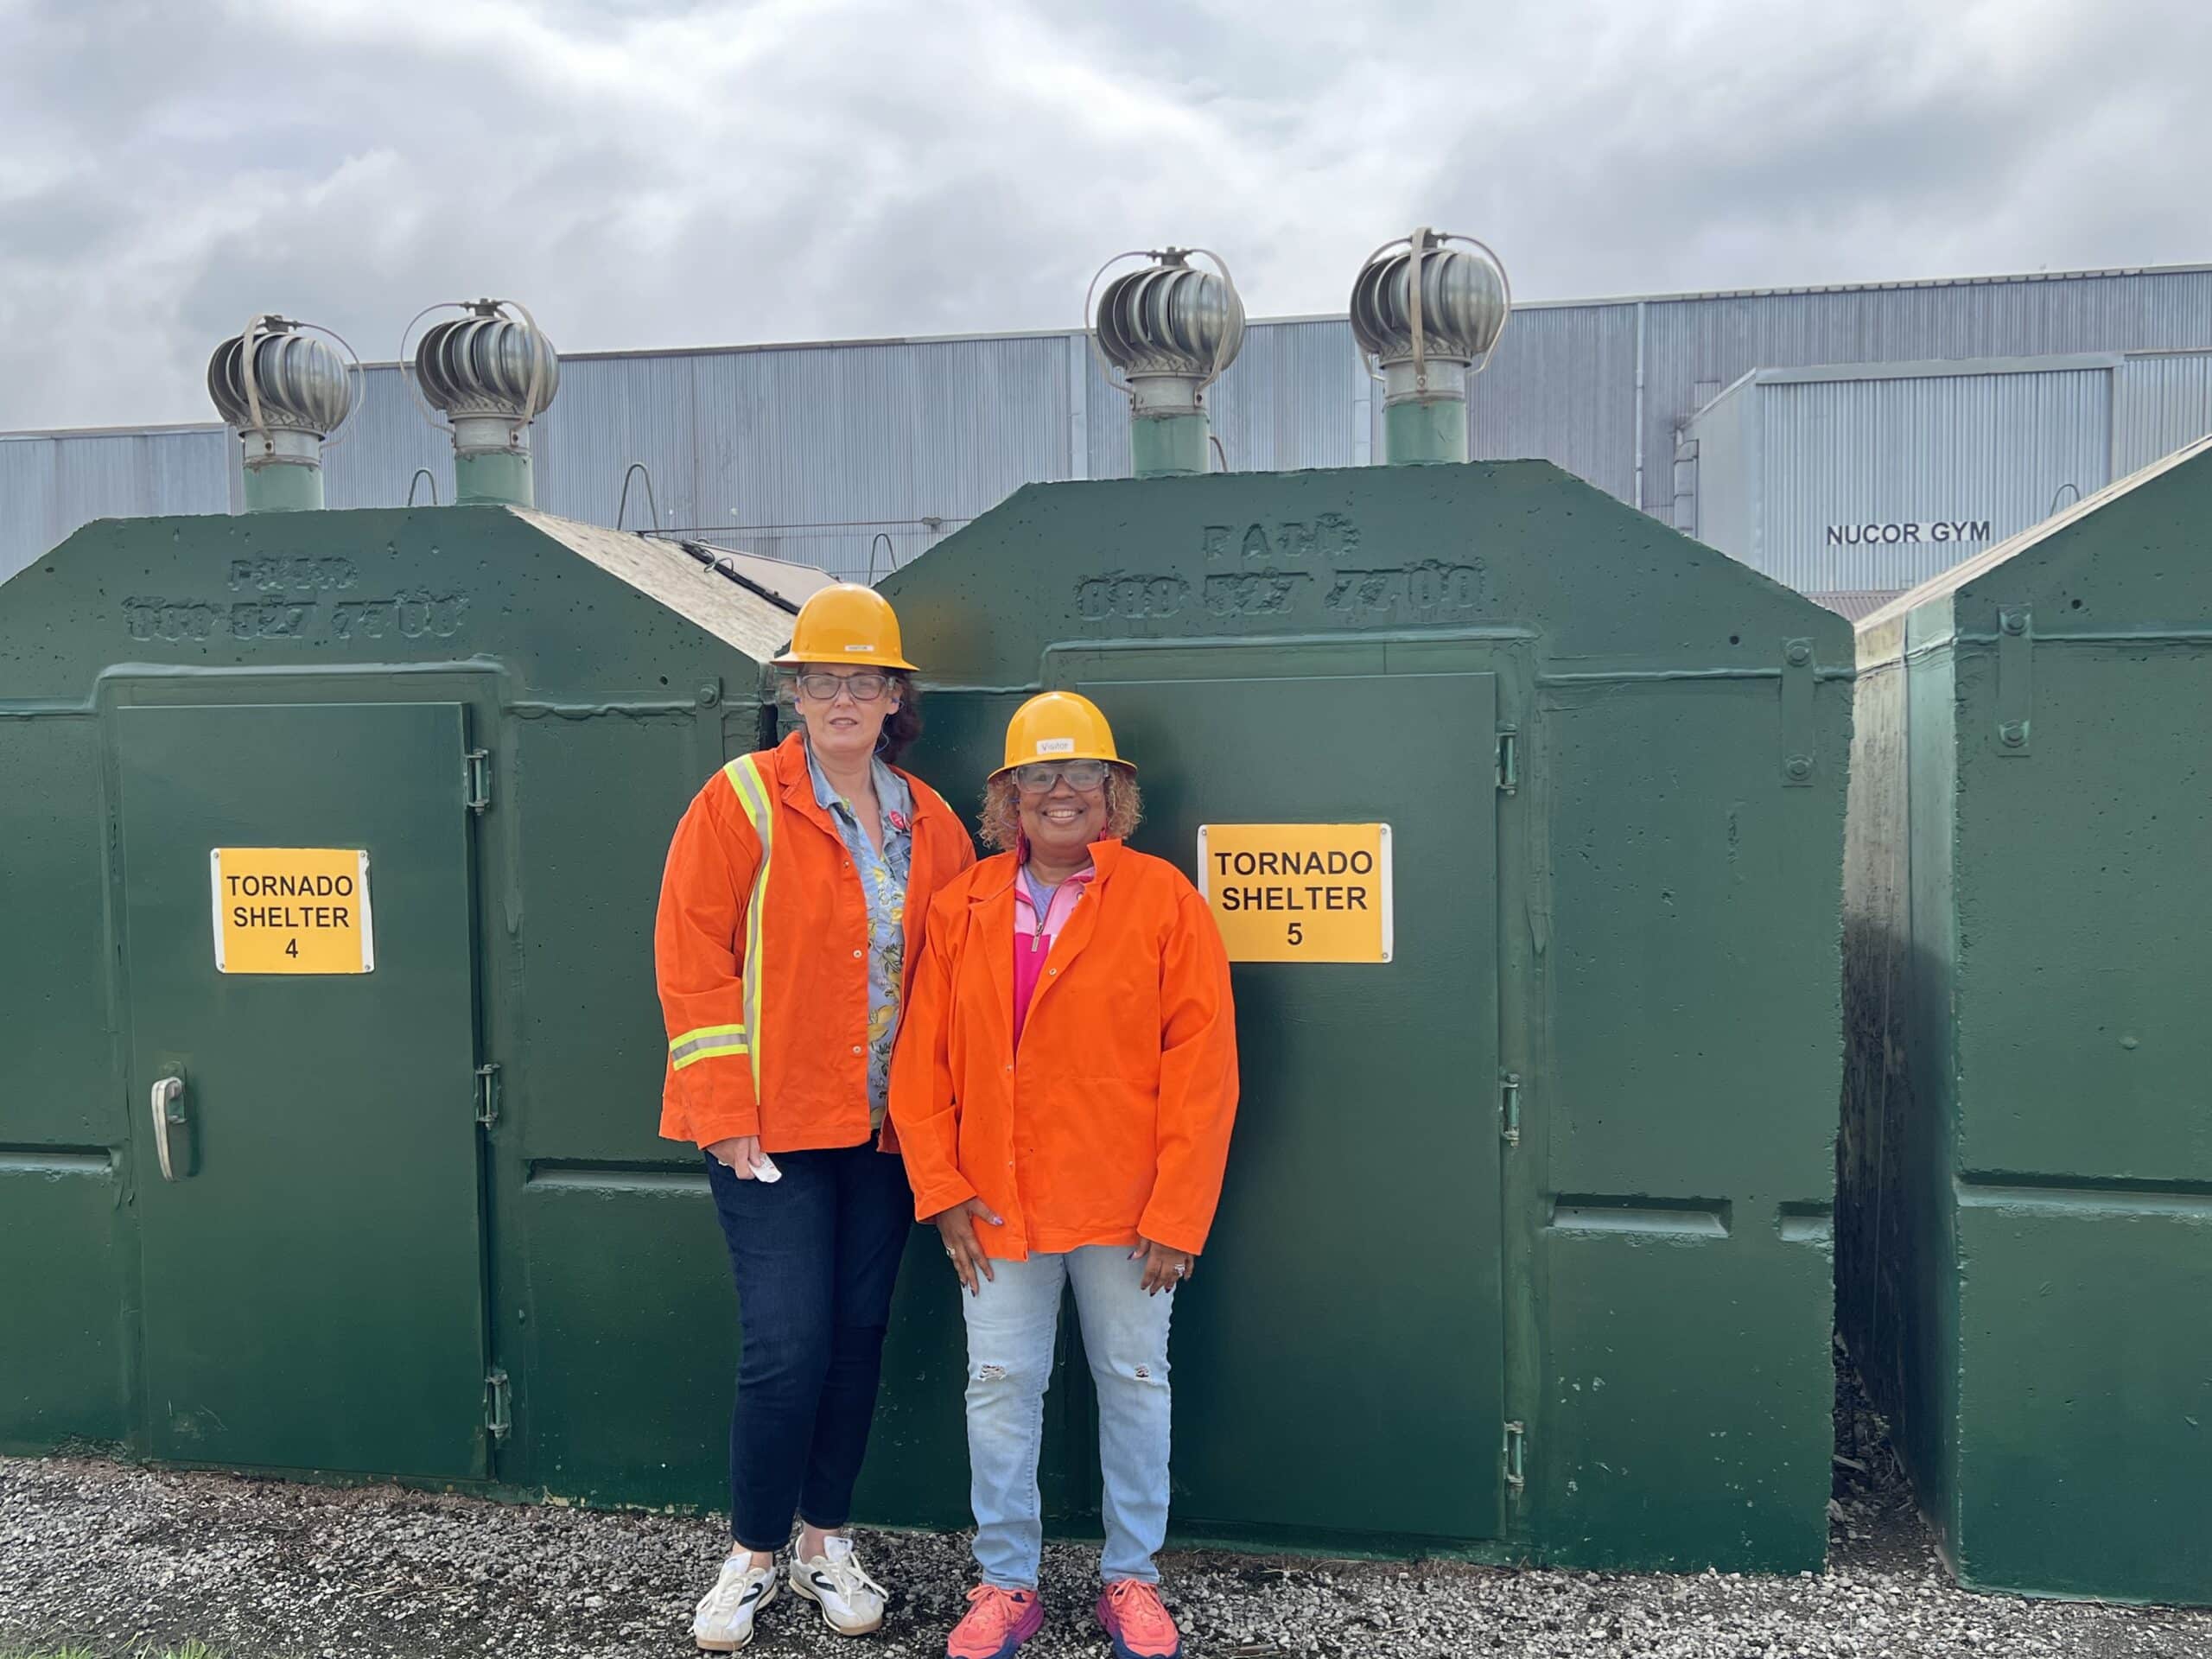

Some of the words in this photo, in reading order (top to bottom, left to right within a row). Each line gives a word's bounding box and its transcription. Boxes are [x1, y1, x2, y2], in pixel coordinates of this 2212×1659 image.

[1827, 524, 1920, 545] NUCOR
[1931, 520, 1991, 543] GYM
[1041, 741, 1069, 752] Visitor
[1214, 850, 1373, 876] TORNADO
[226, 875, 353, 897] TORNADO
[1222, 887, 1368, 911] SHELTER
[233, 906, 350, 928] SHELTER
[1287, 922, 1303, 946] 5
[284, 938, 299, 958] 4
